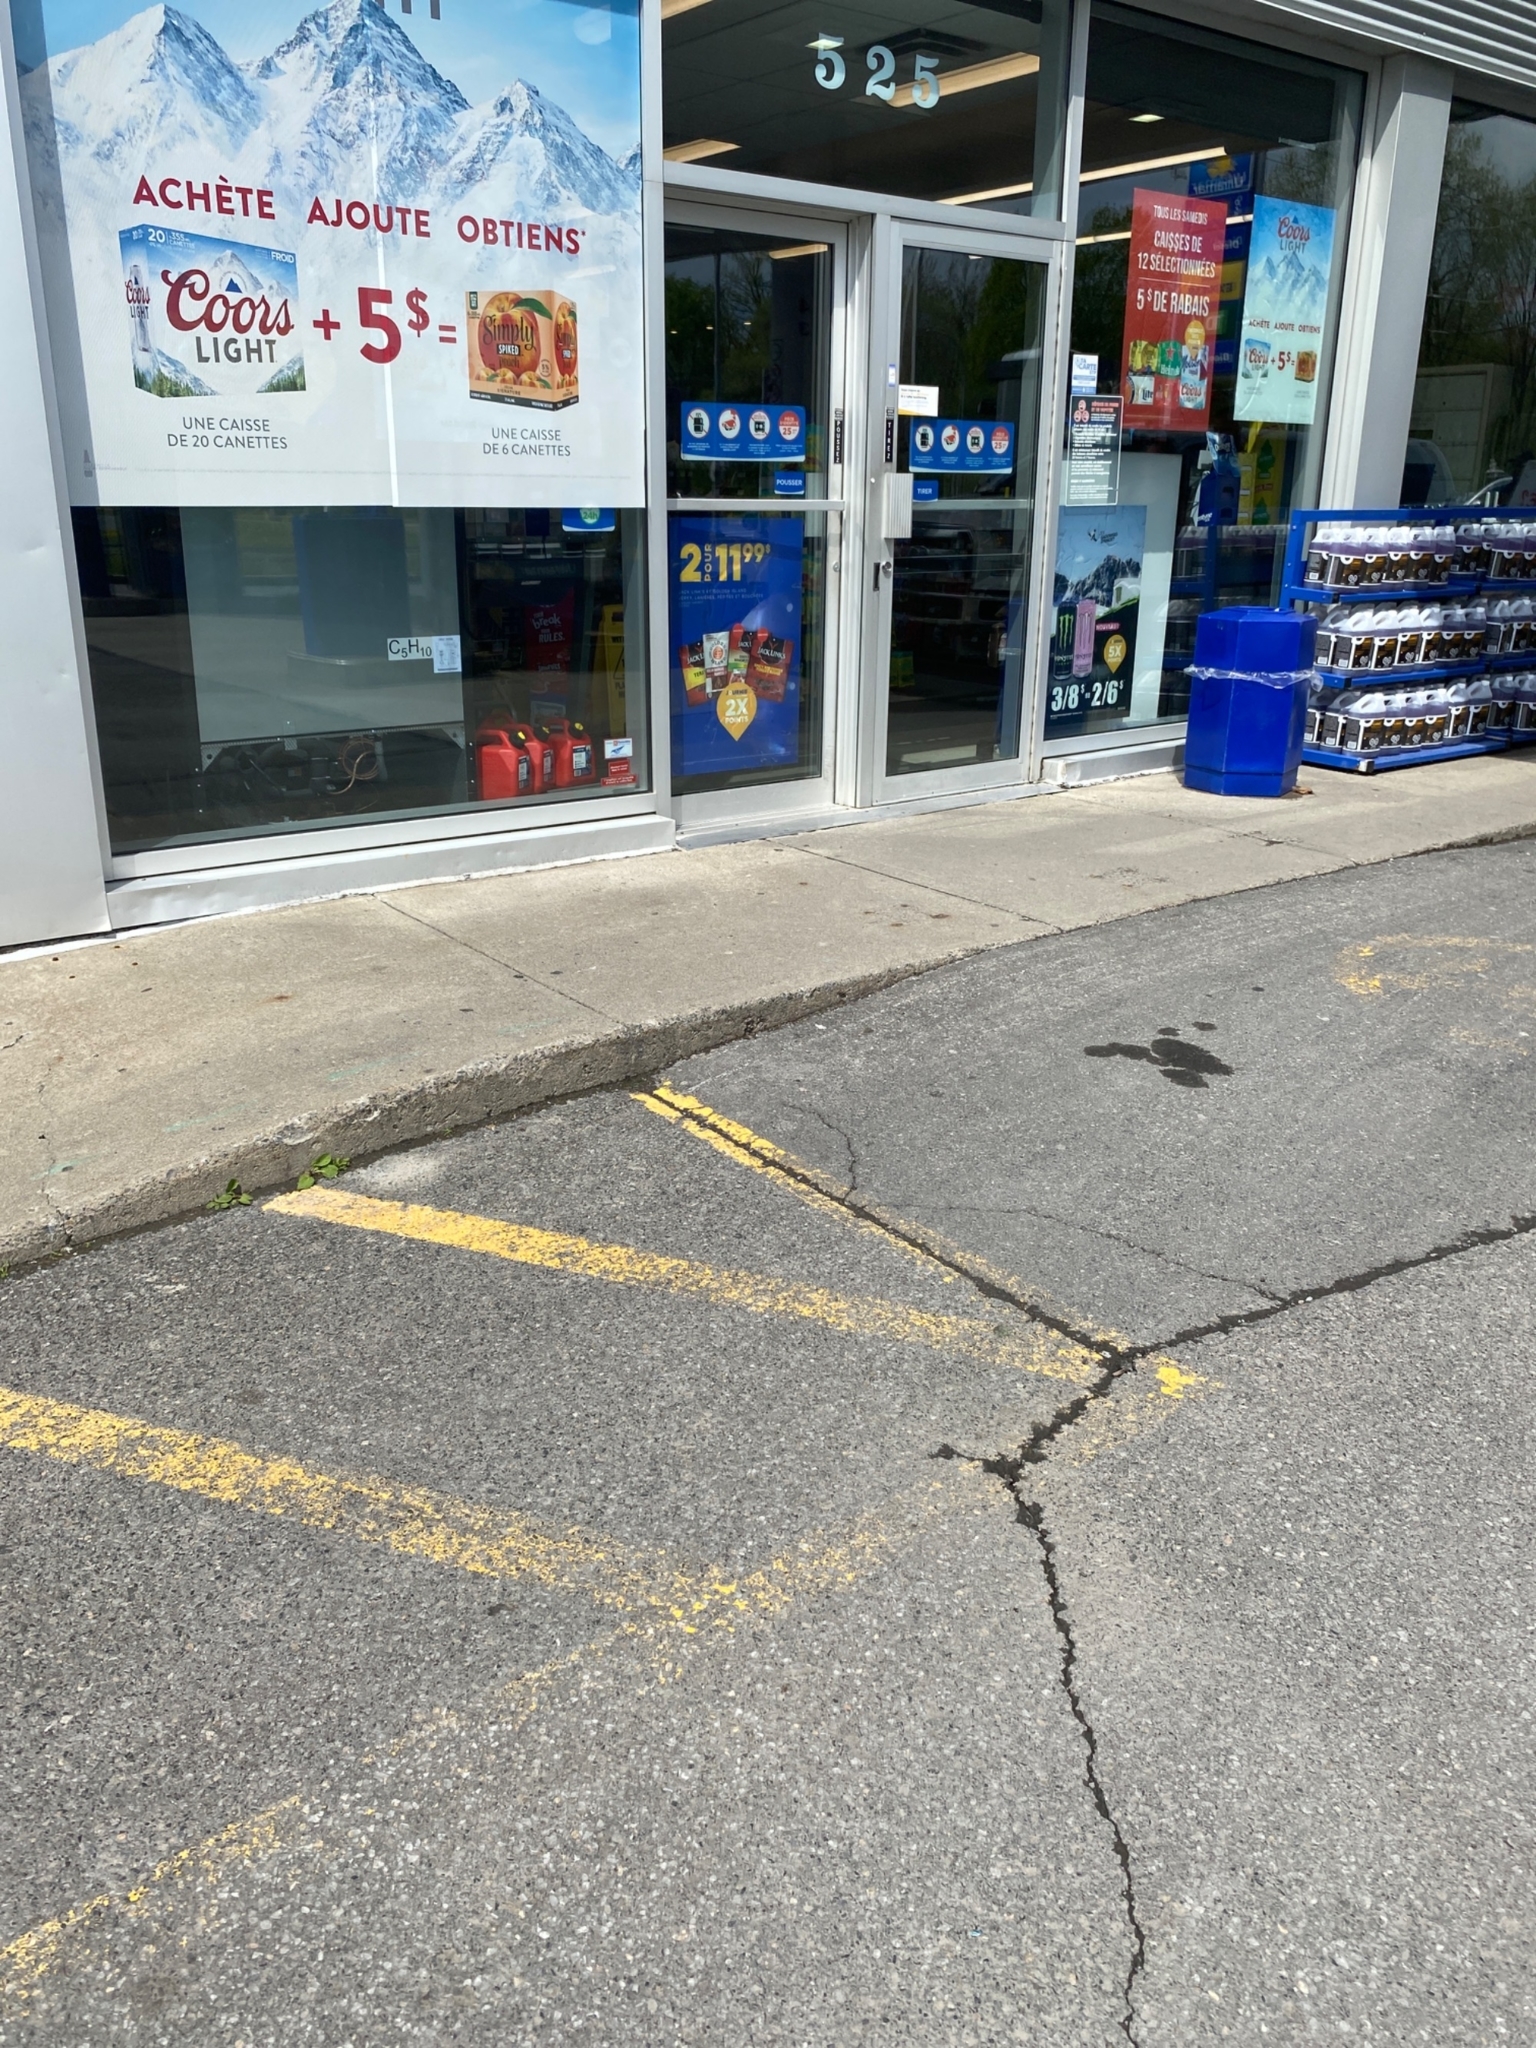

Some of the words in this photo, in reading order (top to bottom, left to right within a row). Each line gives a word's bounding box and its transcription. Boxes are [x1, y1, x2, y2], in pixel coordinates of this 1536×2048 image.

[132, 174, 276, 220] ACHÈTE
[307, 196, 430, 238] AJOUTE
[1153, 205, 1169, 220] TOUS
[1169, 208, 1181, 221] LES
[1181, 209, 1209, 226] SAMEDIS
[148, 229, 166, 243] 20
[1277, 216, 1311, 242] Coors
[1191, 236, 1203, 253] DE
[1279, 239, 1307, 254] LIGHT
[271, 250, 295, 264] FROID
[1137, 252, 1148, 270] 12
[1149, 251, 1217, 278] SÉLECTIONNÉES
[125, 279, 151, 305] Coors
[160, 268, 295, 336] Coors
[1153, 290, 1168, 313] DE
[1170, 292, 1210, 318] RABAIS
[130, 305, 149, 319] LIGHT
[482, 314, 537, 352] Simply
[1248, 317, 1271, 329] ACHÈTE
[1274, 321, 1295, 332] AJOUTE
[1297, 324, 1321, 334] OBTIENS
[195, 336, 277, 363] LIGHT
[498, 344, 520, 356] SPIKED
[1078, 362, 1097, 370] CARTE
[182, 416, 216, 431] UNE
[218, 418, 271, 432] CAISSE
[782, 427, 793, 436] 25
[167, 433, 189, 447] DE
[191, 434, 210, 448] 20
[213, 434, 288, 450] CANETTES
[491, 427, 518, 440] UNE
[520, 428, 562, 441] CAISSE
[835, 419, 843, 464] POUSSEZ
[482, 442, 500, 455] DE
[502, 443, 509, 455] 6
[511, 443, 571, 457] CANETTES
[994, 442, 1002, 450] 25
[776, 478, 803, 486] POUSSER
[917, 487, 933, 495] TIRER
[582, 511, 598, 520] 24h
[680, 542, 702, 582] 2
[704, 543, 712, 582] POUR
[757, 647, 771, 656] JACK
[1108, 645, 1121, 658] 5X
[725, 697, 749, 717] 2X
[724, 715, 749, 724] POINTS
